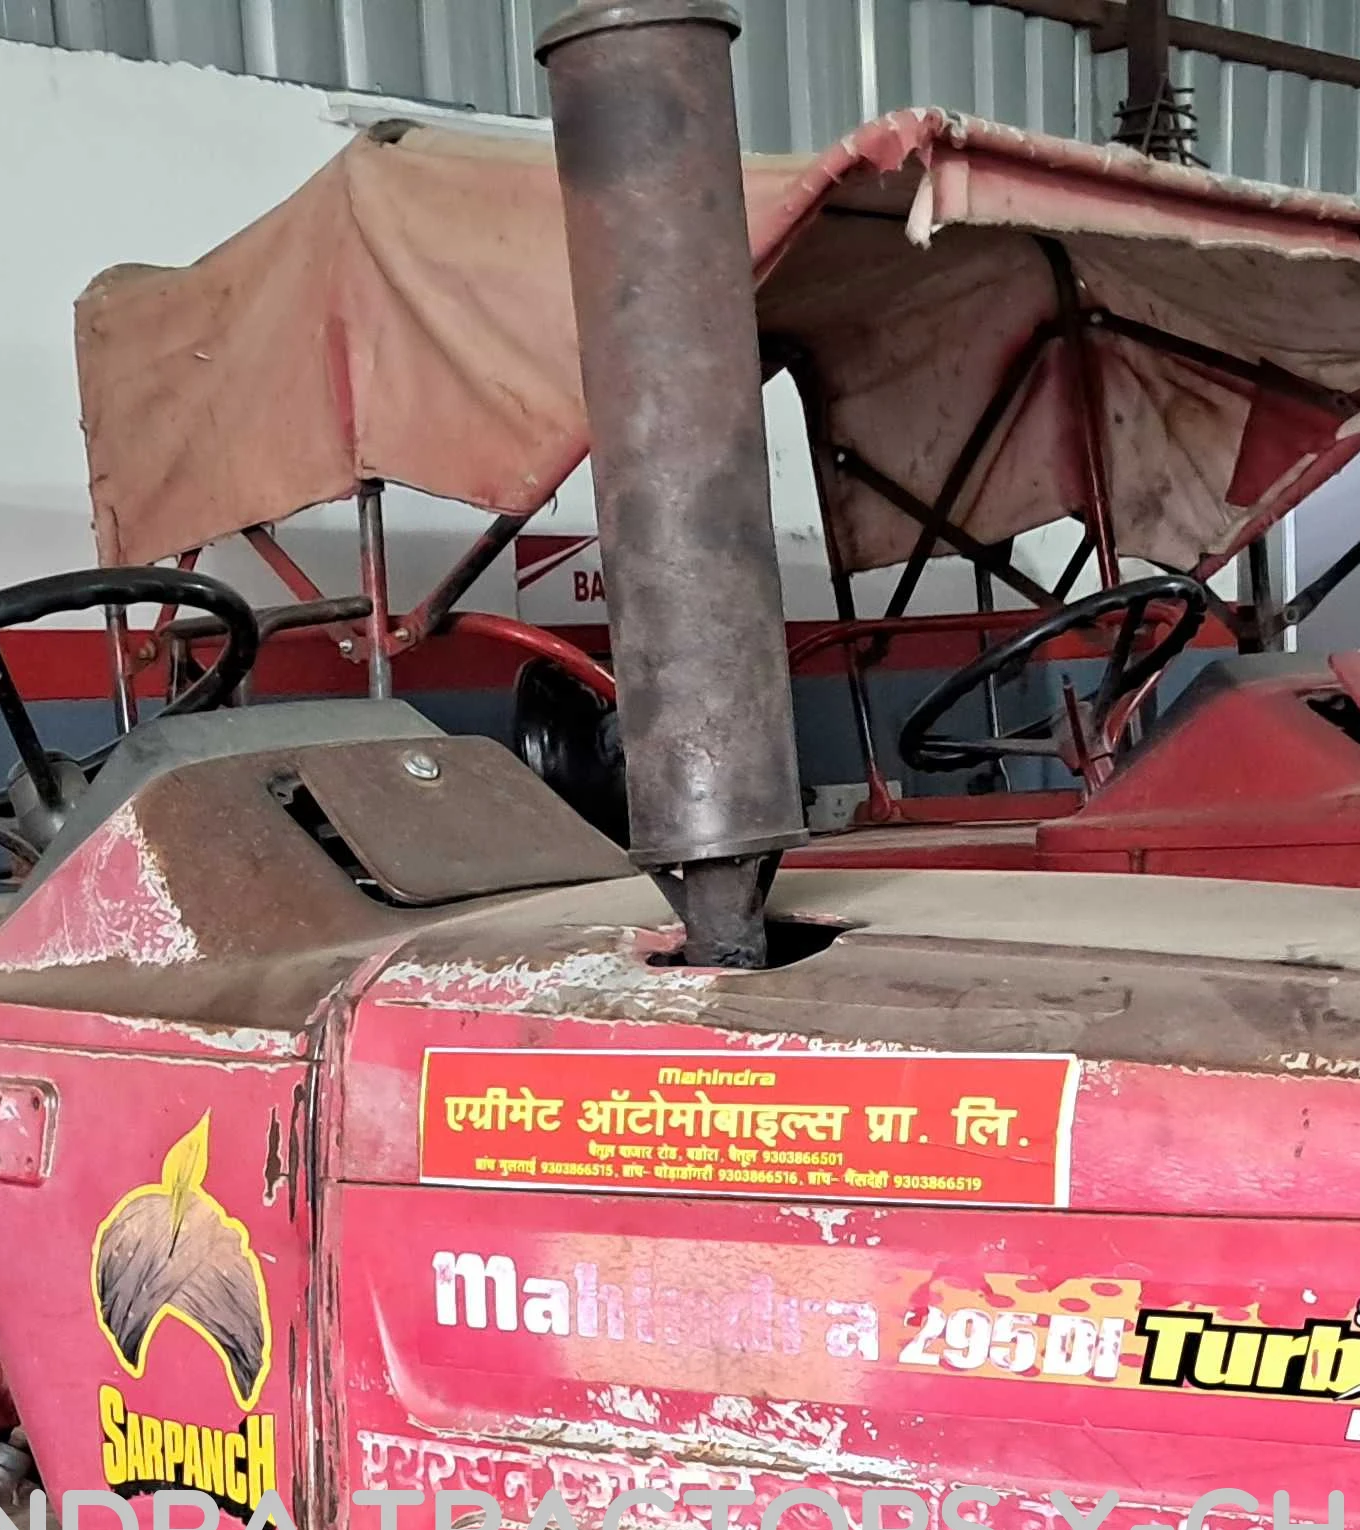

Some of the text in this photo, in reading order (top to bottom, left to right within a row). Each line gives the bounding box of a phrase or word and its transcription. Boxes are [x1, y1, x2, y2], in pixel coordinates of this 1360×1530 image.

[658, 1067, 776, 1087] Mahindra
[444, 1086, 563, 1132] एग्रीमेट
[577, 1088, 850, 1147] ऑटोमोबाइल्स
[762, 1150, 843, 1166] 9303866501
[894, 1175, 982, 1191] 9303866519
